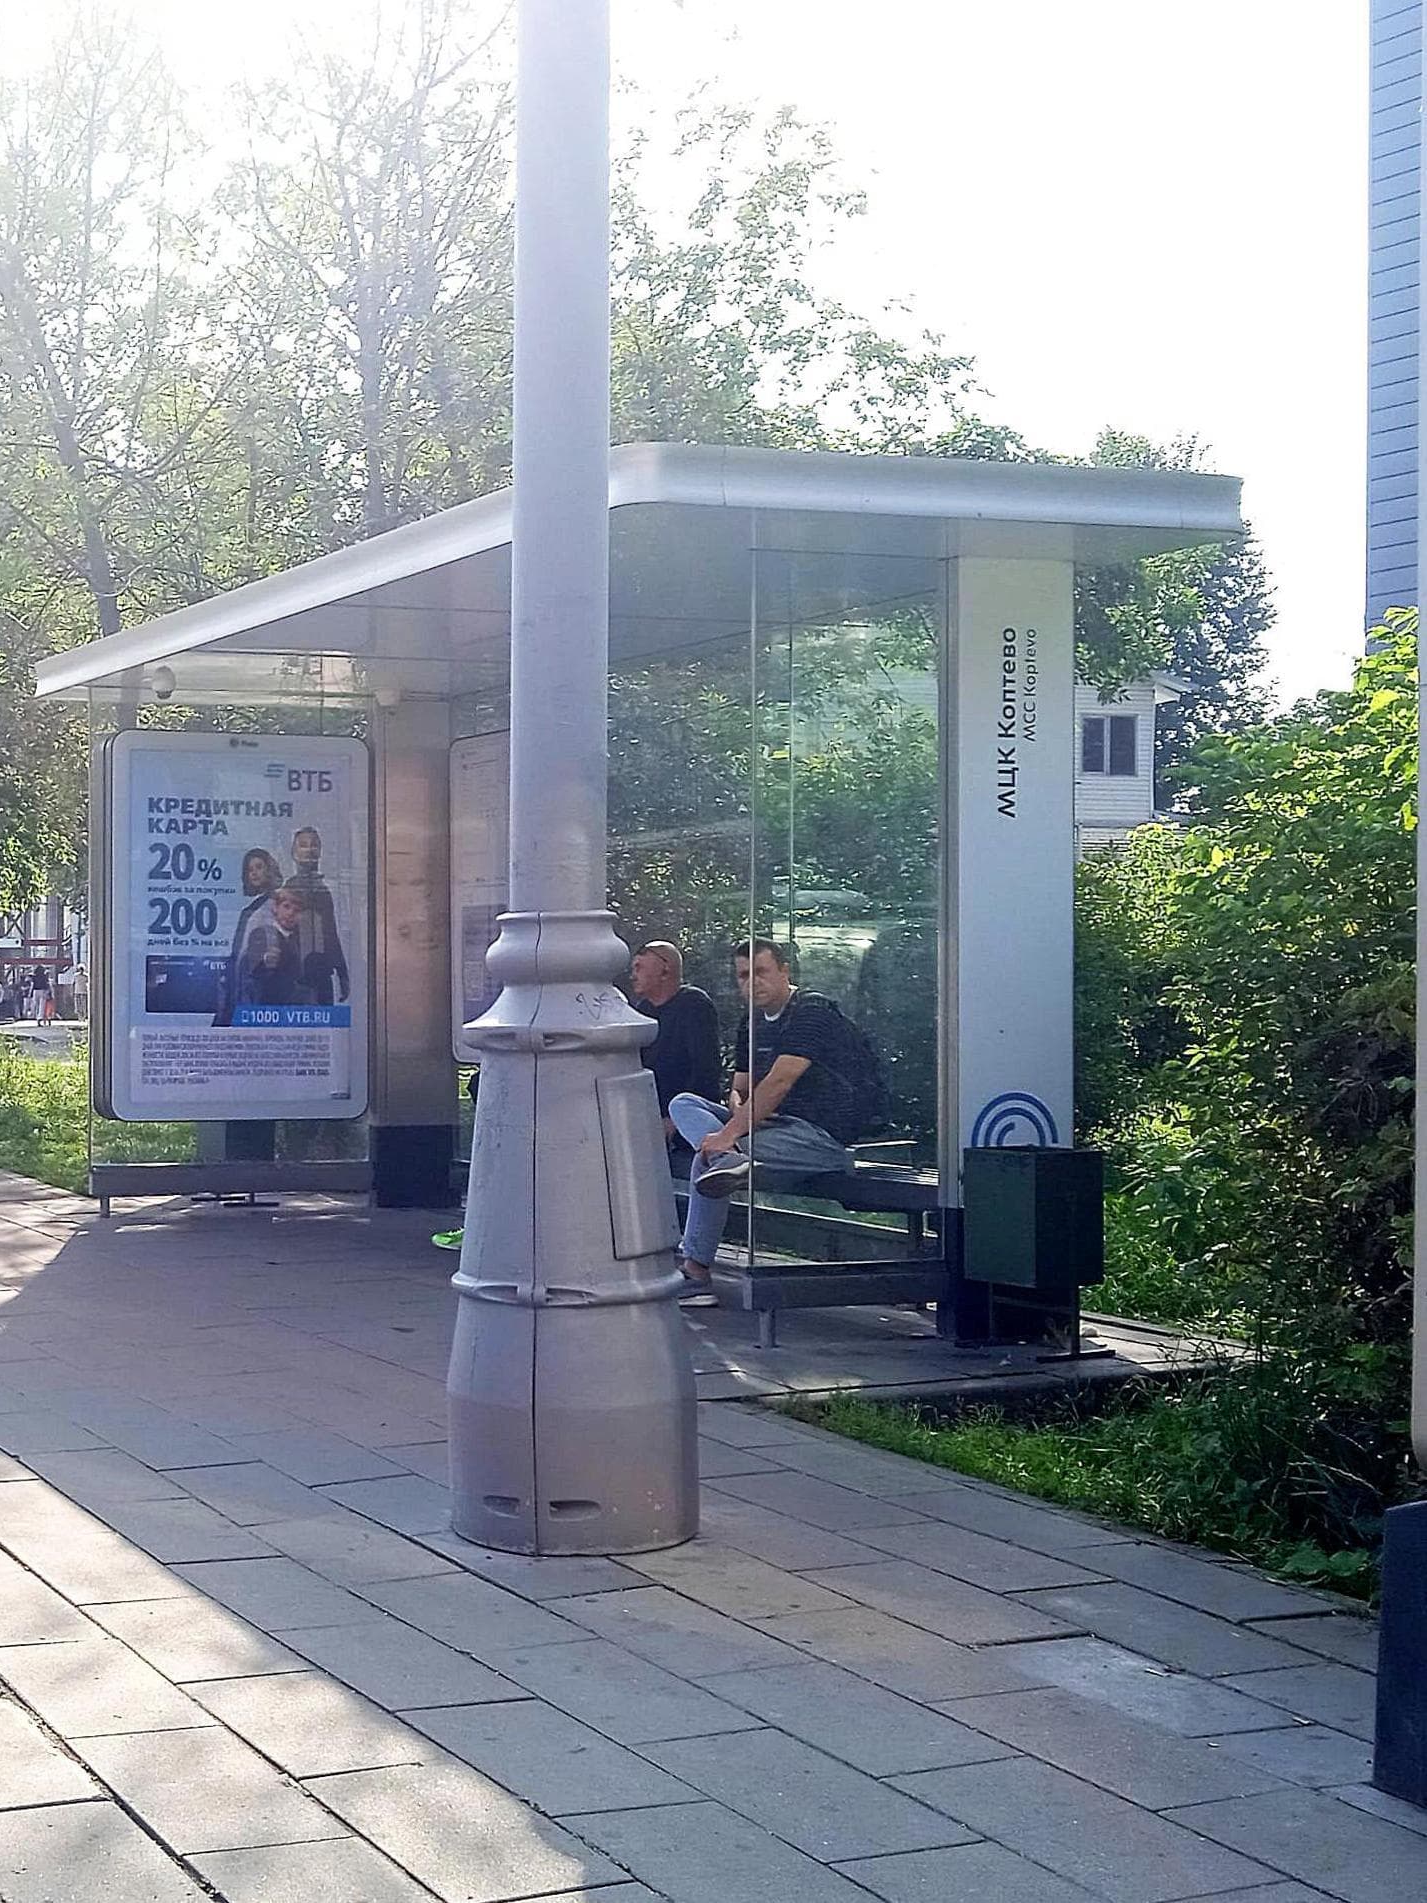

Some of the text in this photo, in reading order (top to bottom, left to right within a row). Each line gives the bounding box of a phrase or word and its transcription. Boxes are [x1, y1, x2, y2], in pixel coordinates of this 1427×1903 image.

[997, 628, 1019, 818] МЦК Коптево
[1023, 700, 1036, 742] MCC
[287, 769, 333, 792] ВТБ
[147, 797, 293, 818] КРЕДИТНАЯ
[147, 818, 229, 836] КАРТА
[148, 897, 218, 936] 200
[286, 1011, 330, 1023] VTB.RU
